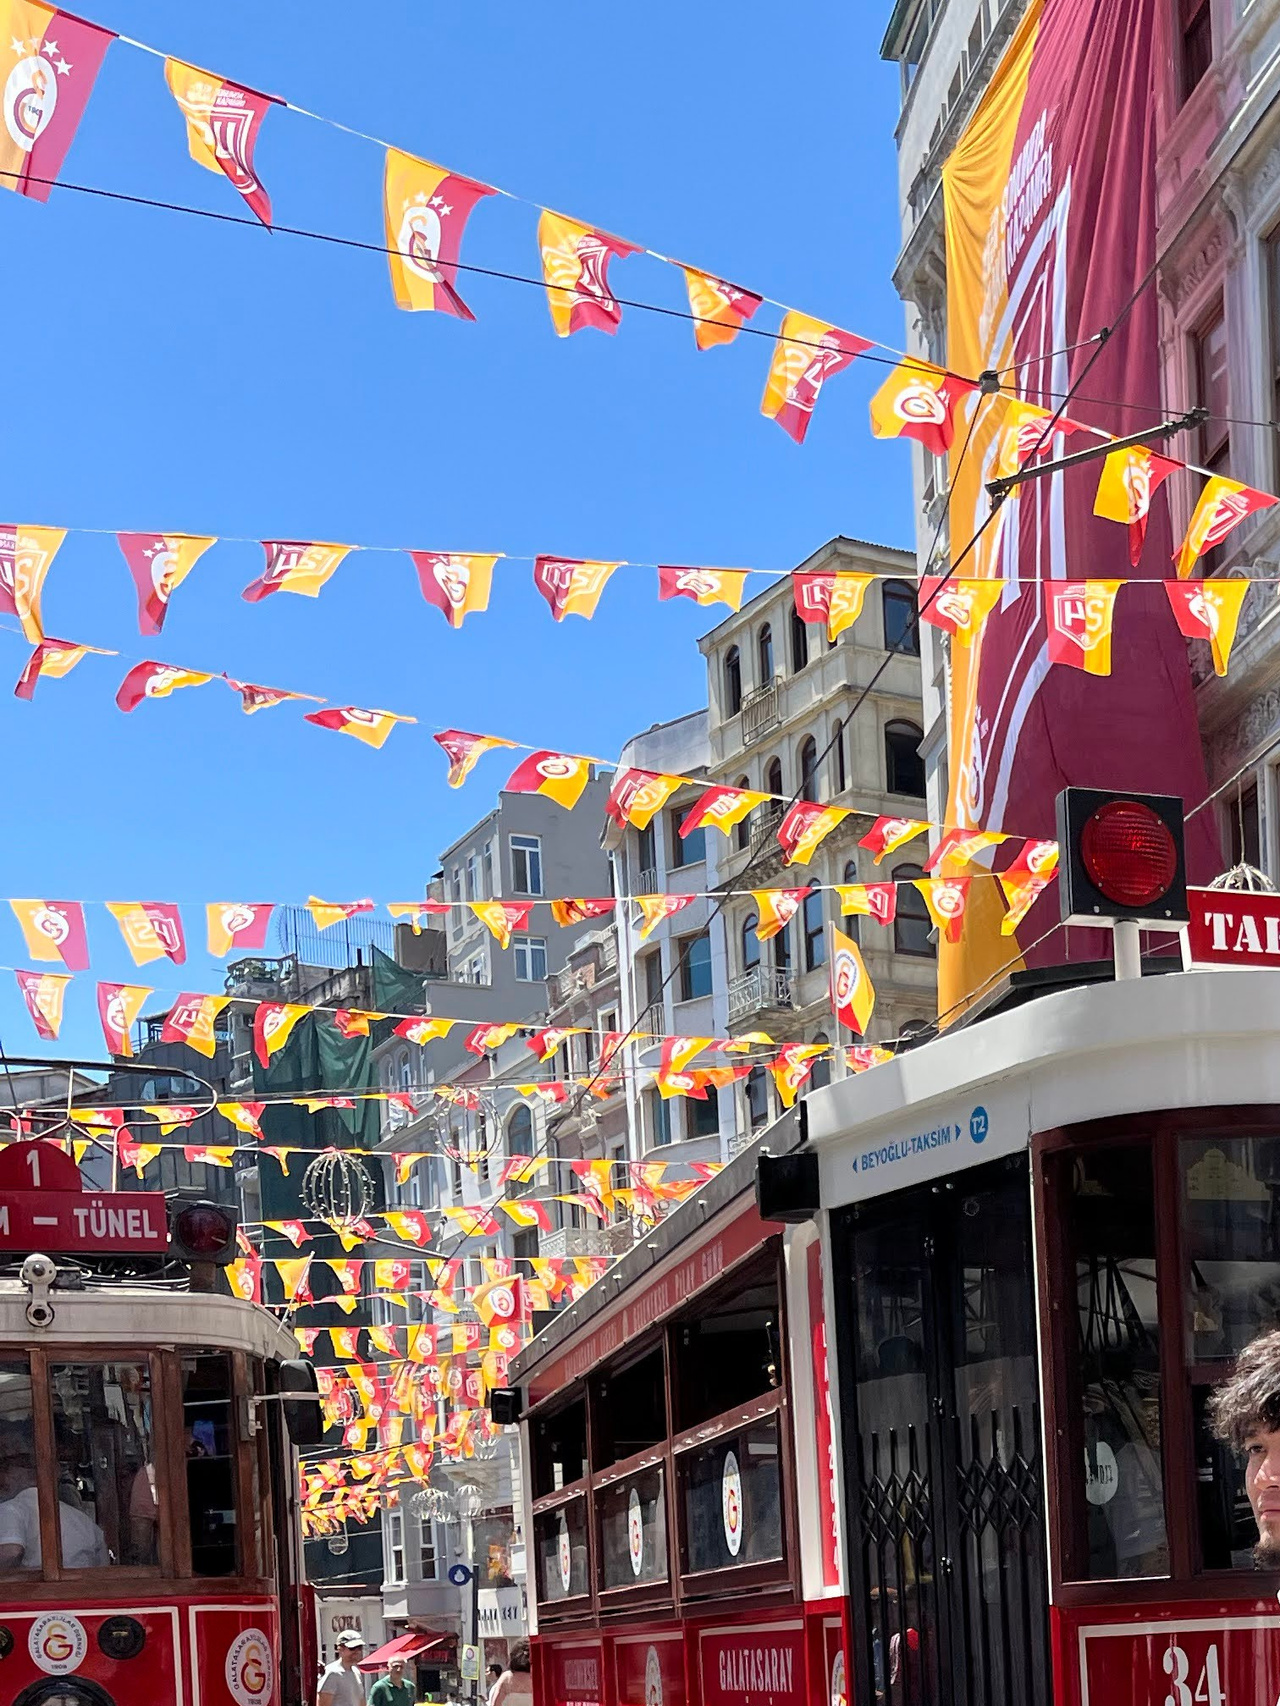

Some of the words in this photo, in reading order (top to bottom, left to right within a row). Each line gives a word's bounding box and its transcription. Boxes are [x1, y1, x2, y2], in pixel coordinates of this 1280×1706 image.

[971, 1115, 986, 1136] T2
[861, 1125, 951, 1171] BEYOĞLU-TAKSİM
[26, 1149, 41, 1187] 1
[73, 1200, 158, 1239] TÜNEL
[718, 1648, 793, 1693] GALATASARAY
